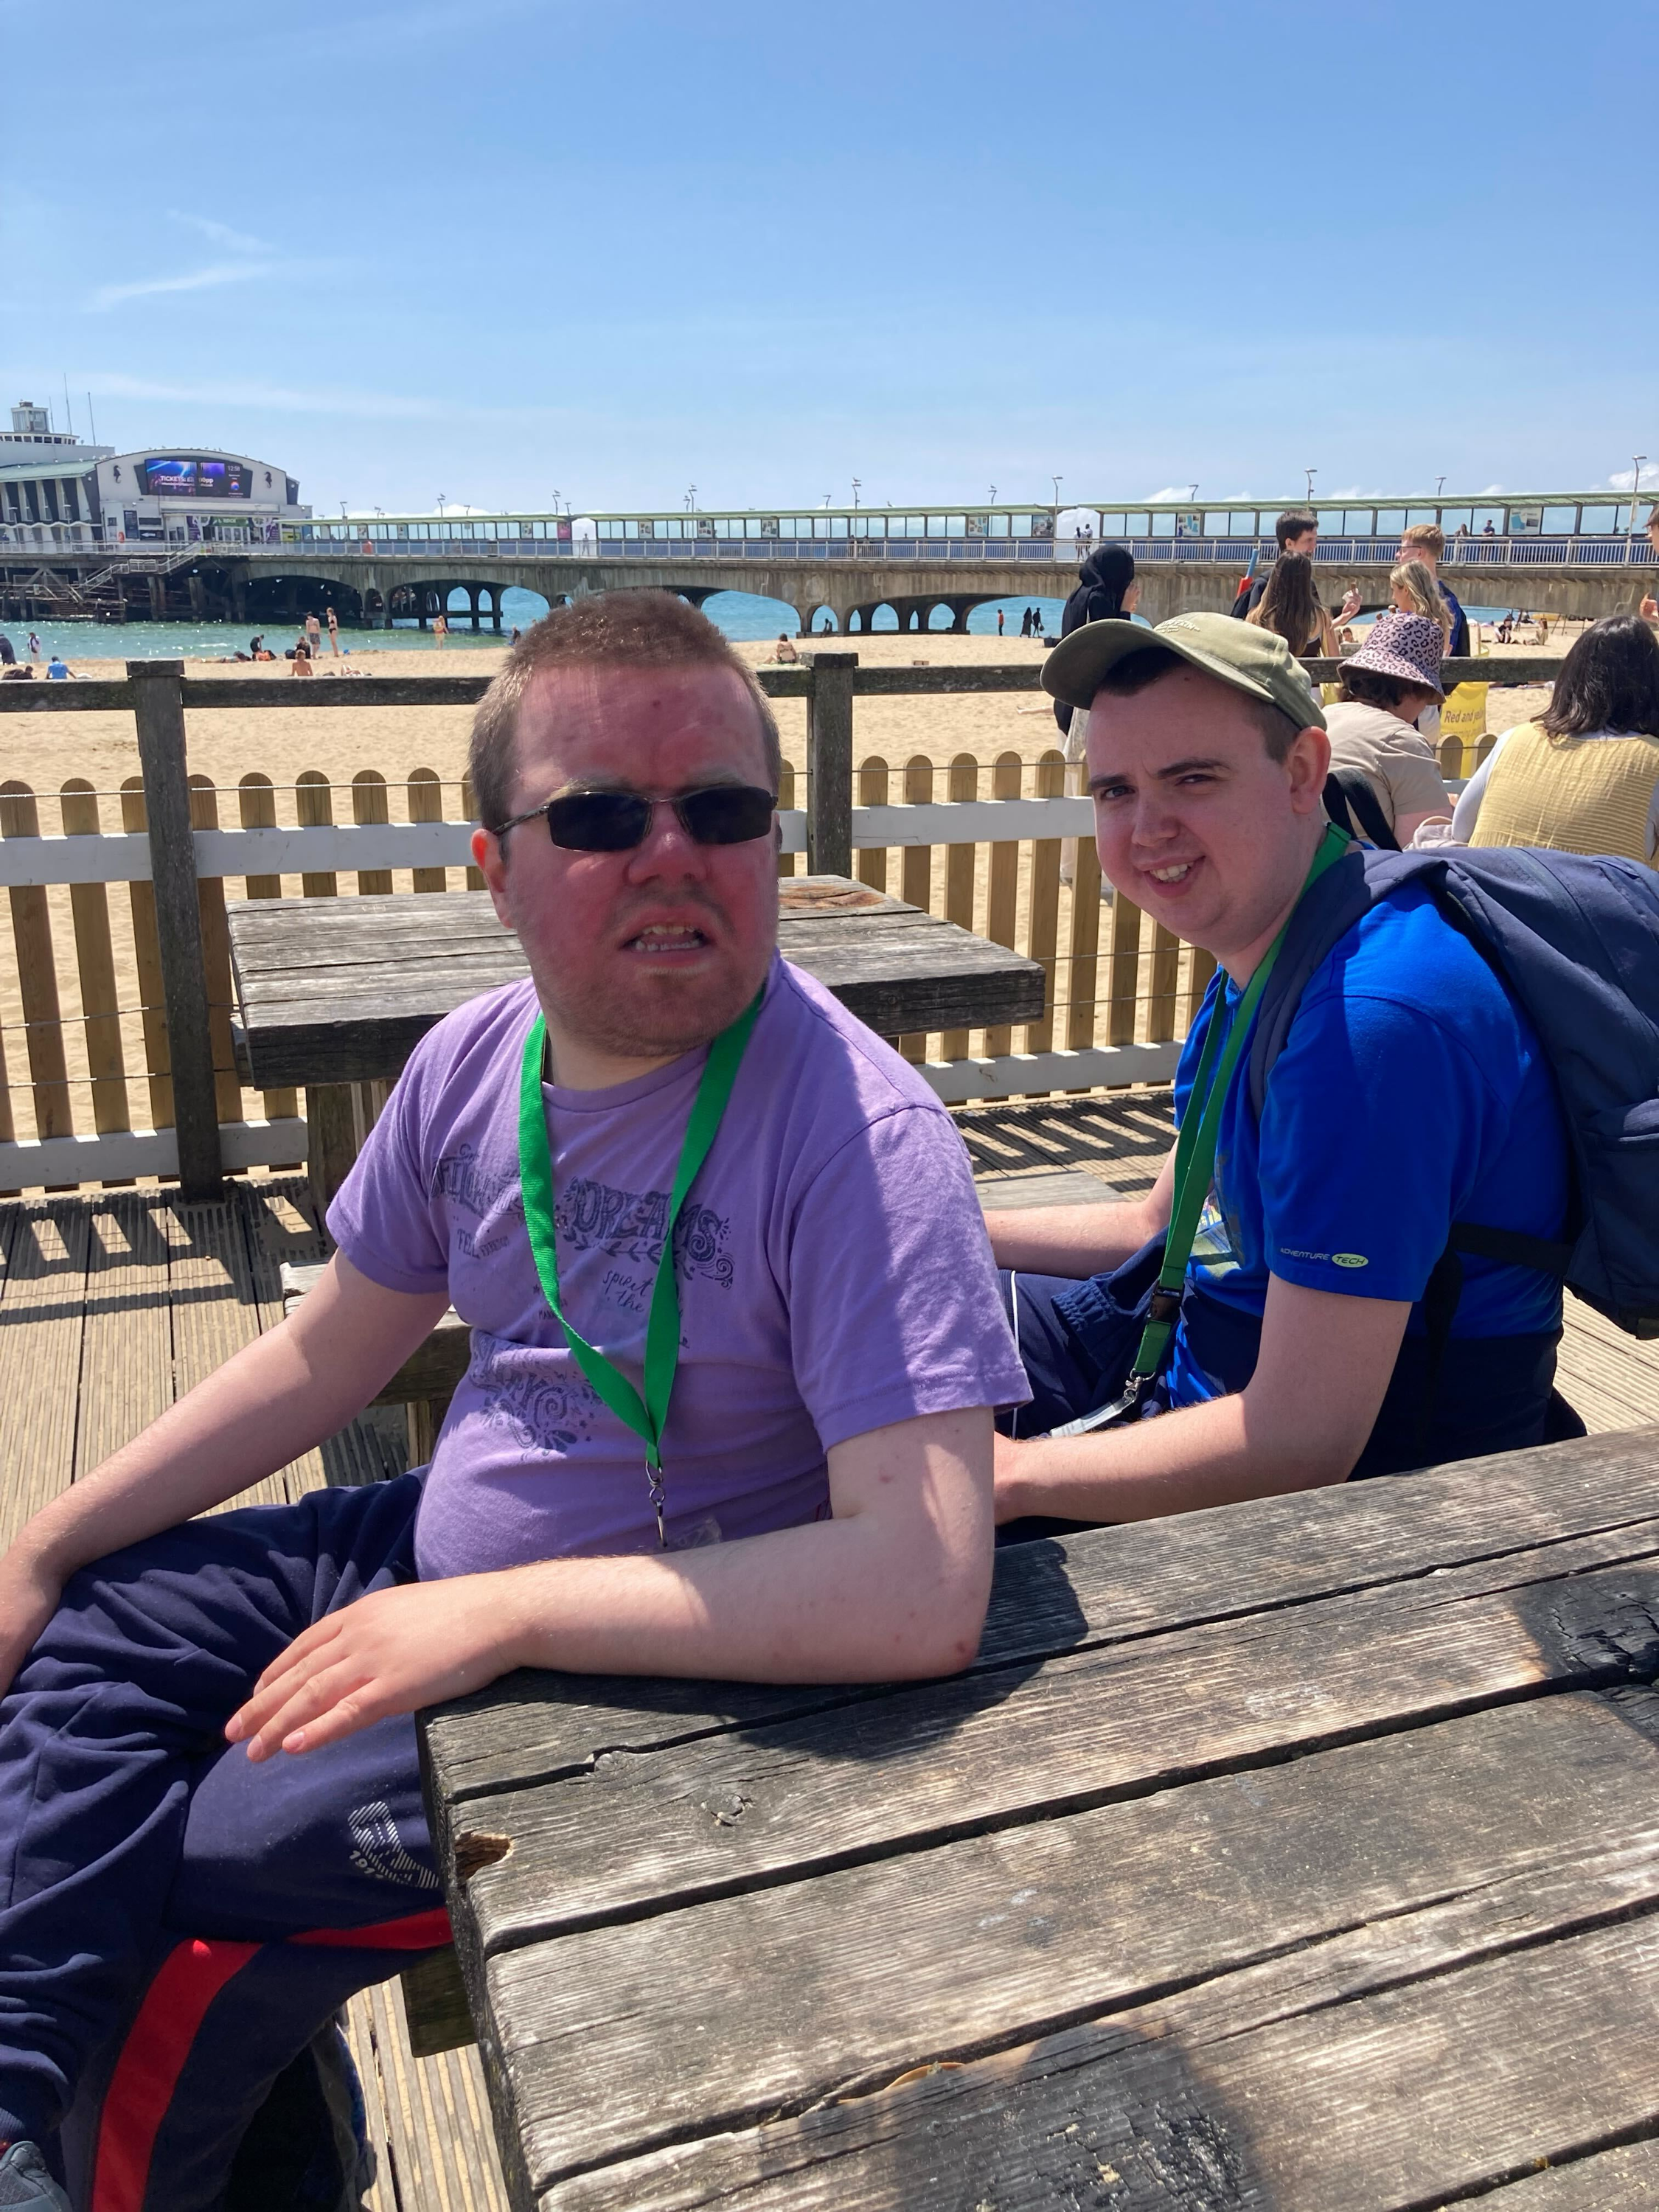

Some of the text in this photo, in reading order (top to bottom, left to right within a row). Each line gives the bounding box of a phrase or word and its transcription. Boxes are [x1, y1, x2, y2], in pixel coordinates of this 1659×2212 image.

[1444, 710, 1461, 723] Red
[1461, 709, 1474, 723] and
[1280, 1248, 1366, 1265] ADVENTURE TECH
